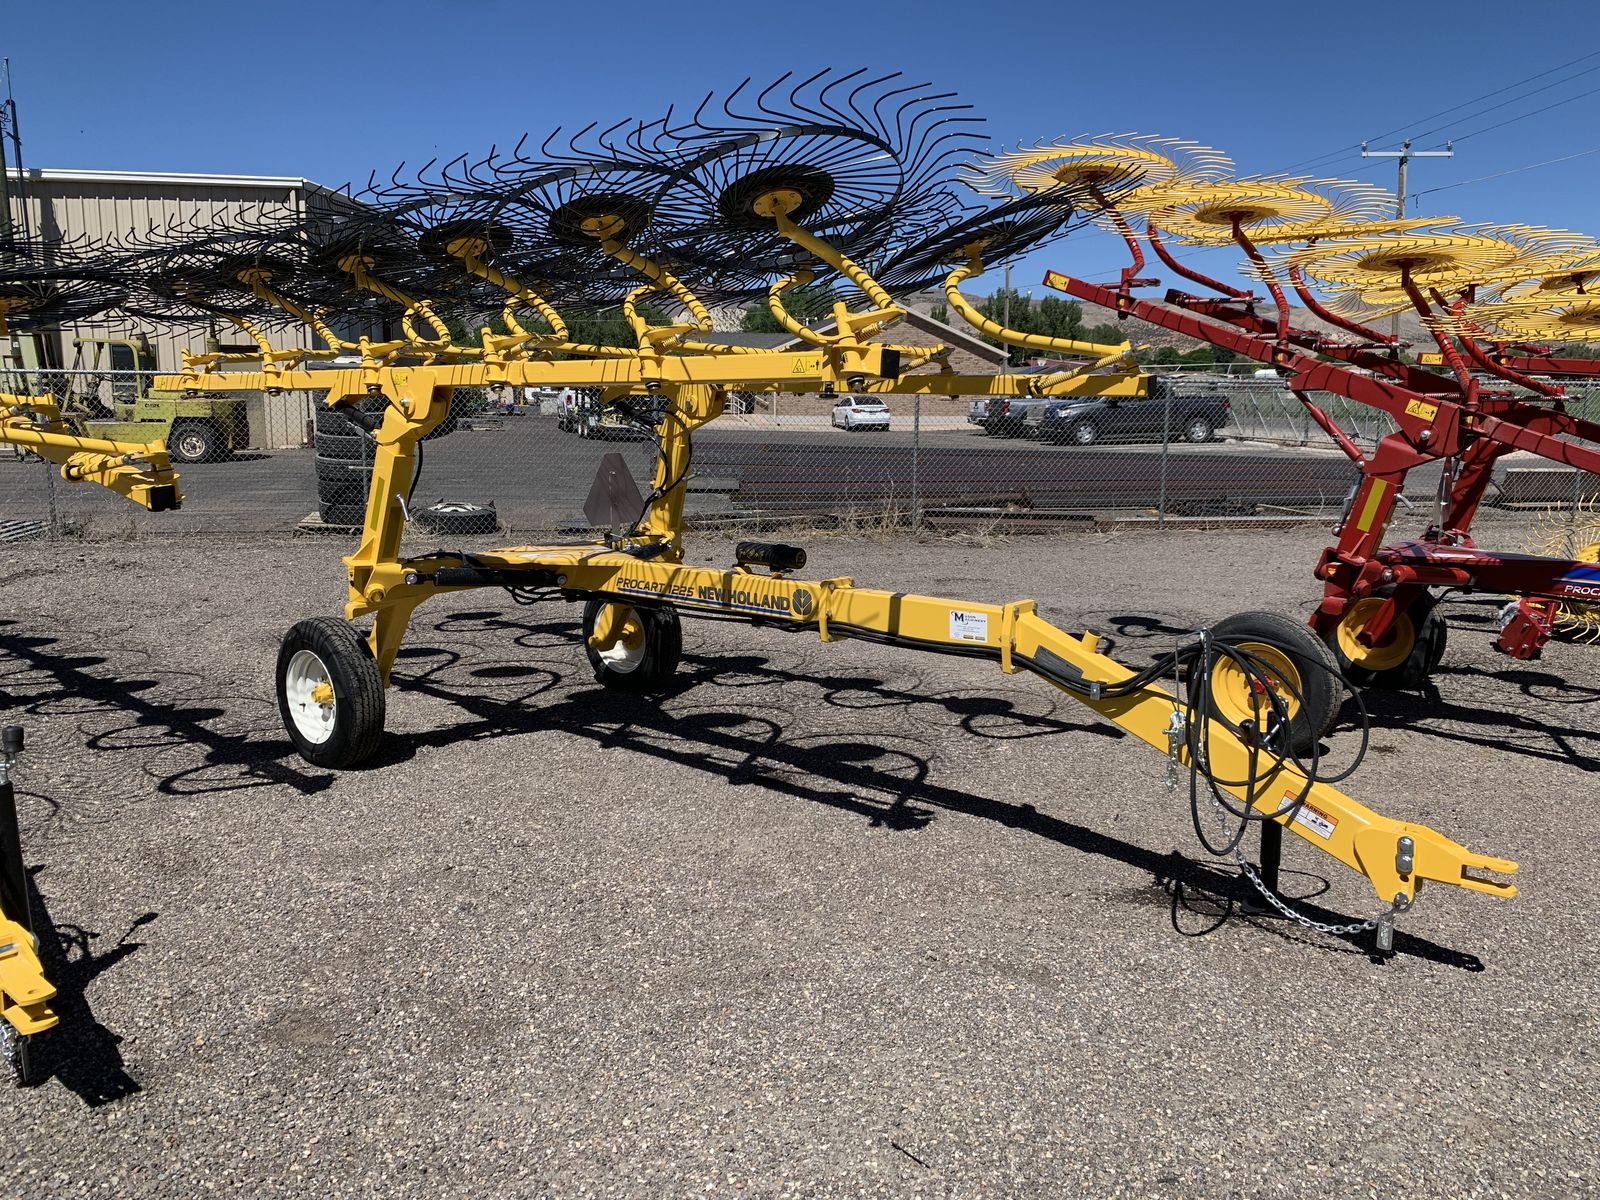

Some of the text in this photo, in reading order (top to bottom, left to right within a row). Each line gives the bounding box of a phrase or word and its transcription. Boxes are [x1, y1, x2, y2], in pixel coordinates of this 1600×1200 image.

[616, 577, 694, 597] PROCART 1225
[1564, 585, 1600, 597] PROC
[698, 585, 790, 611] NEW HOLLAND
